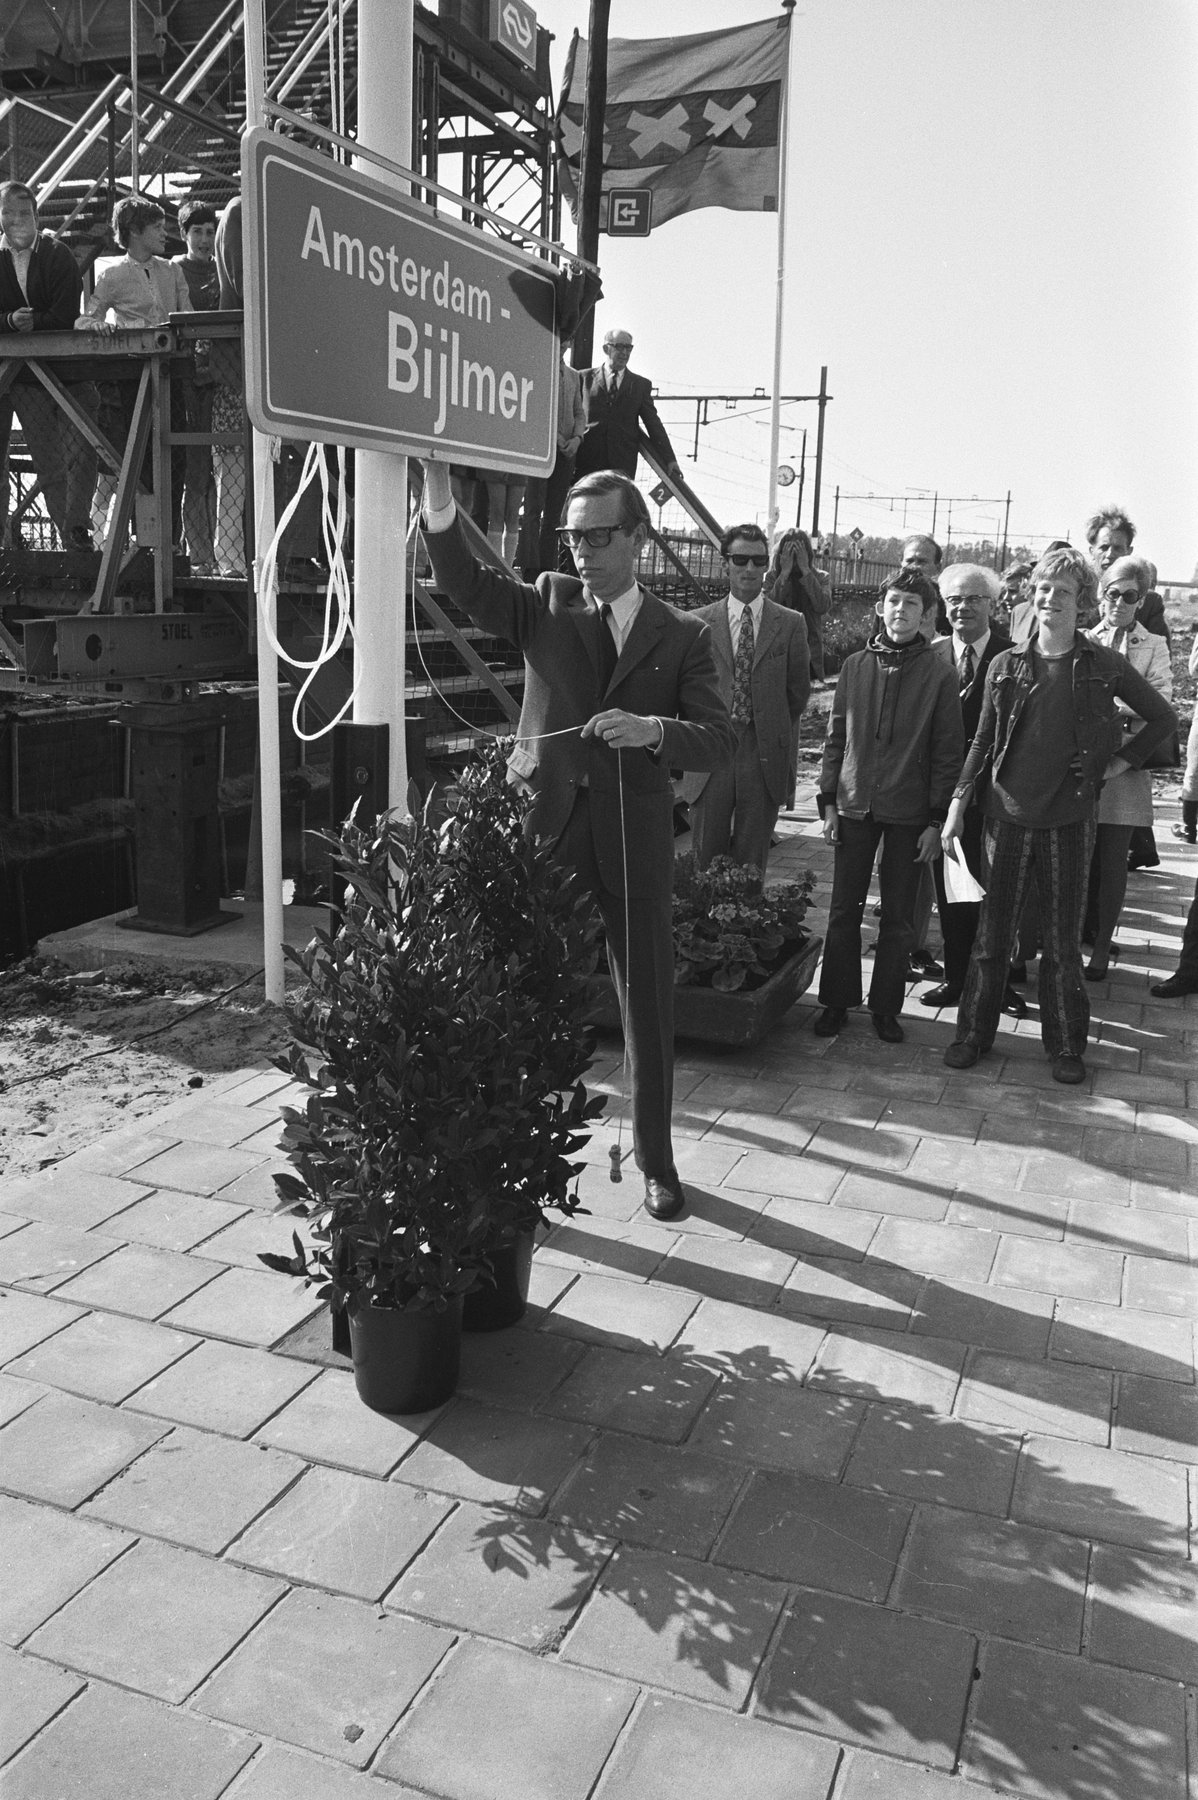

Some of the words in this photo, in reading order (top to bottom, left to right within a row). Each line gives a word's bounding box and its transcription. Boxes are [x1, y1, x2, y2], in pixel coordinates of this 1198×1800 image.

[301, 205, 491, 323] Amsterdam
[388, 310, 534, 434] Bijlmer
[657, 488, 665, 501] 2
[162, 623, 193, 640] STOEL
